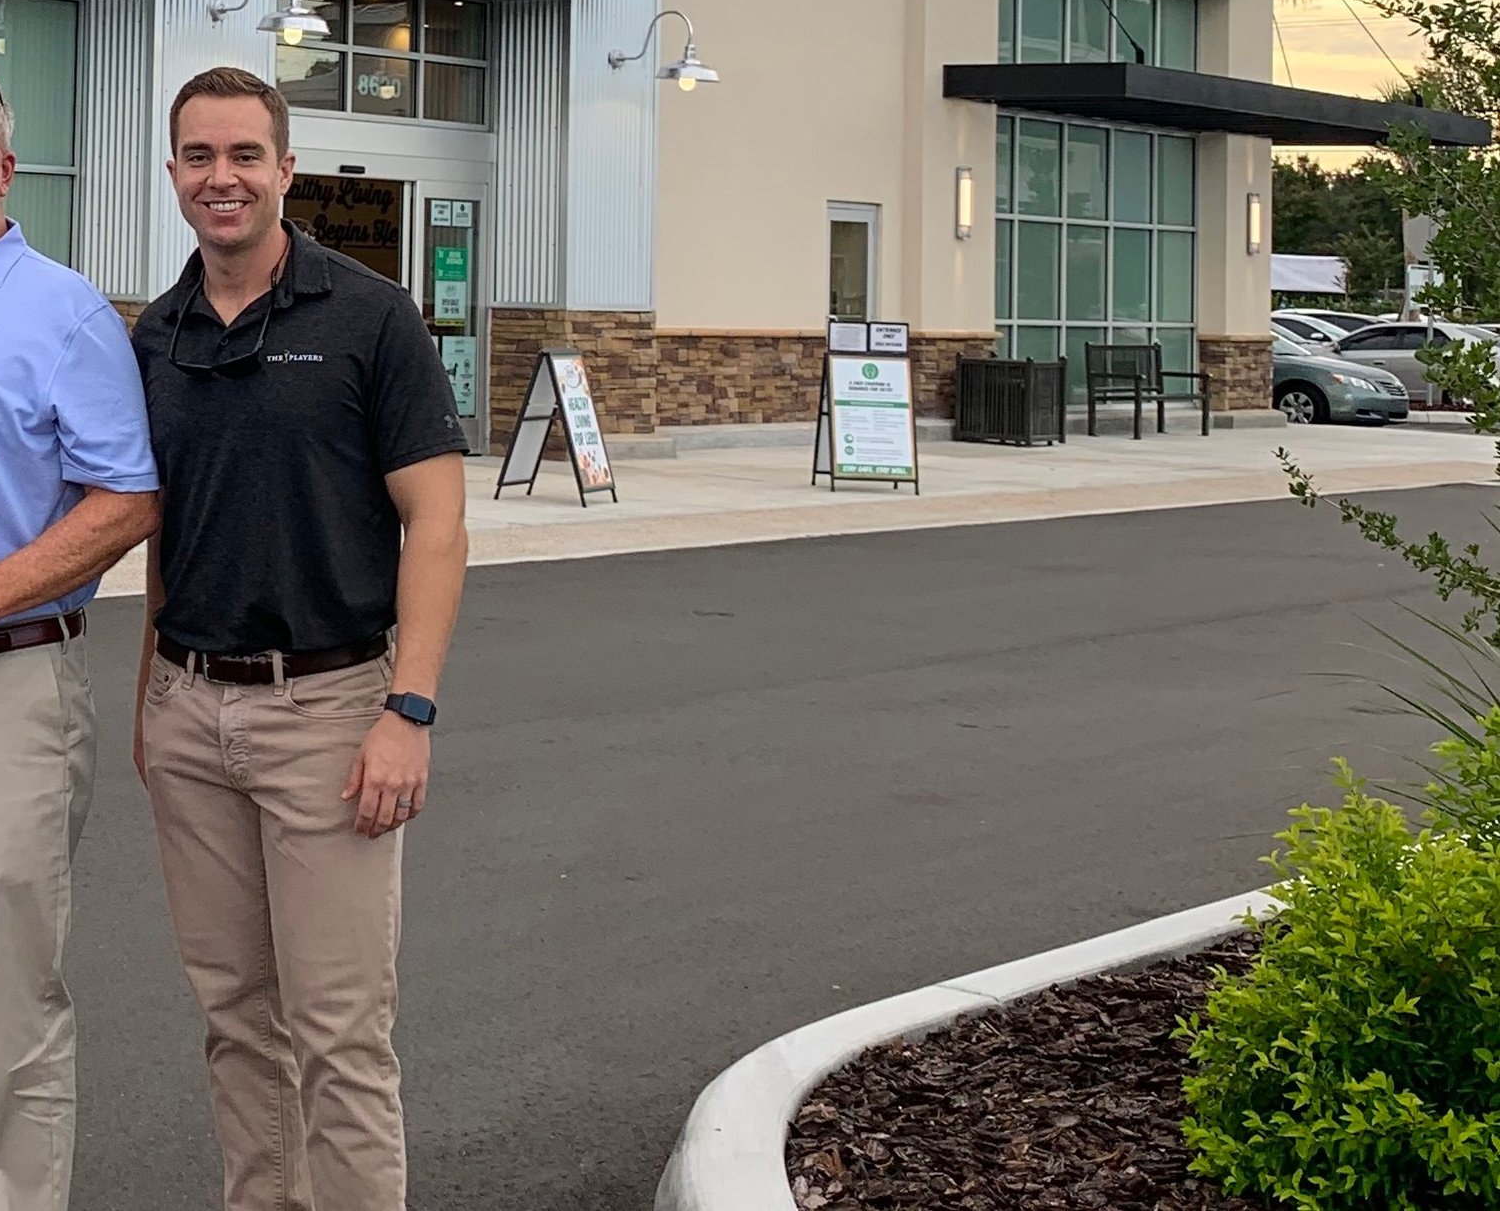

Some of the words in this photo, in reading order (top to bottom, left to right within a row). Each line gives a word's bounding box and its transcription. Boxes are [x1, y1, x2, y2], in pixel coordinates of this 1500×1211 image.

[287, 178, 336, 210] althy
[372, 218, 399, 245] He
[288, 353, 323, 362] PLAYERS
